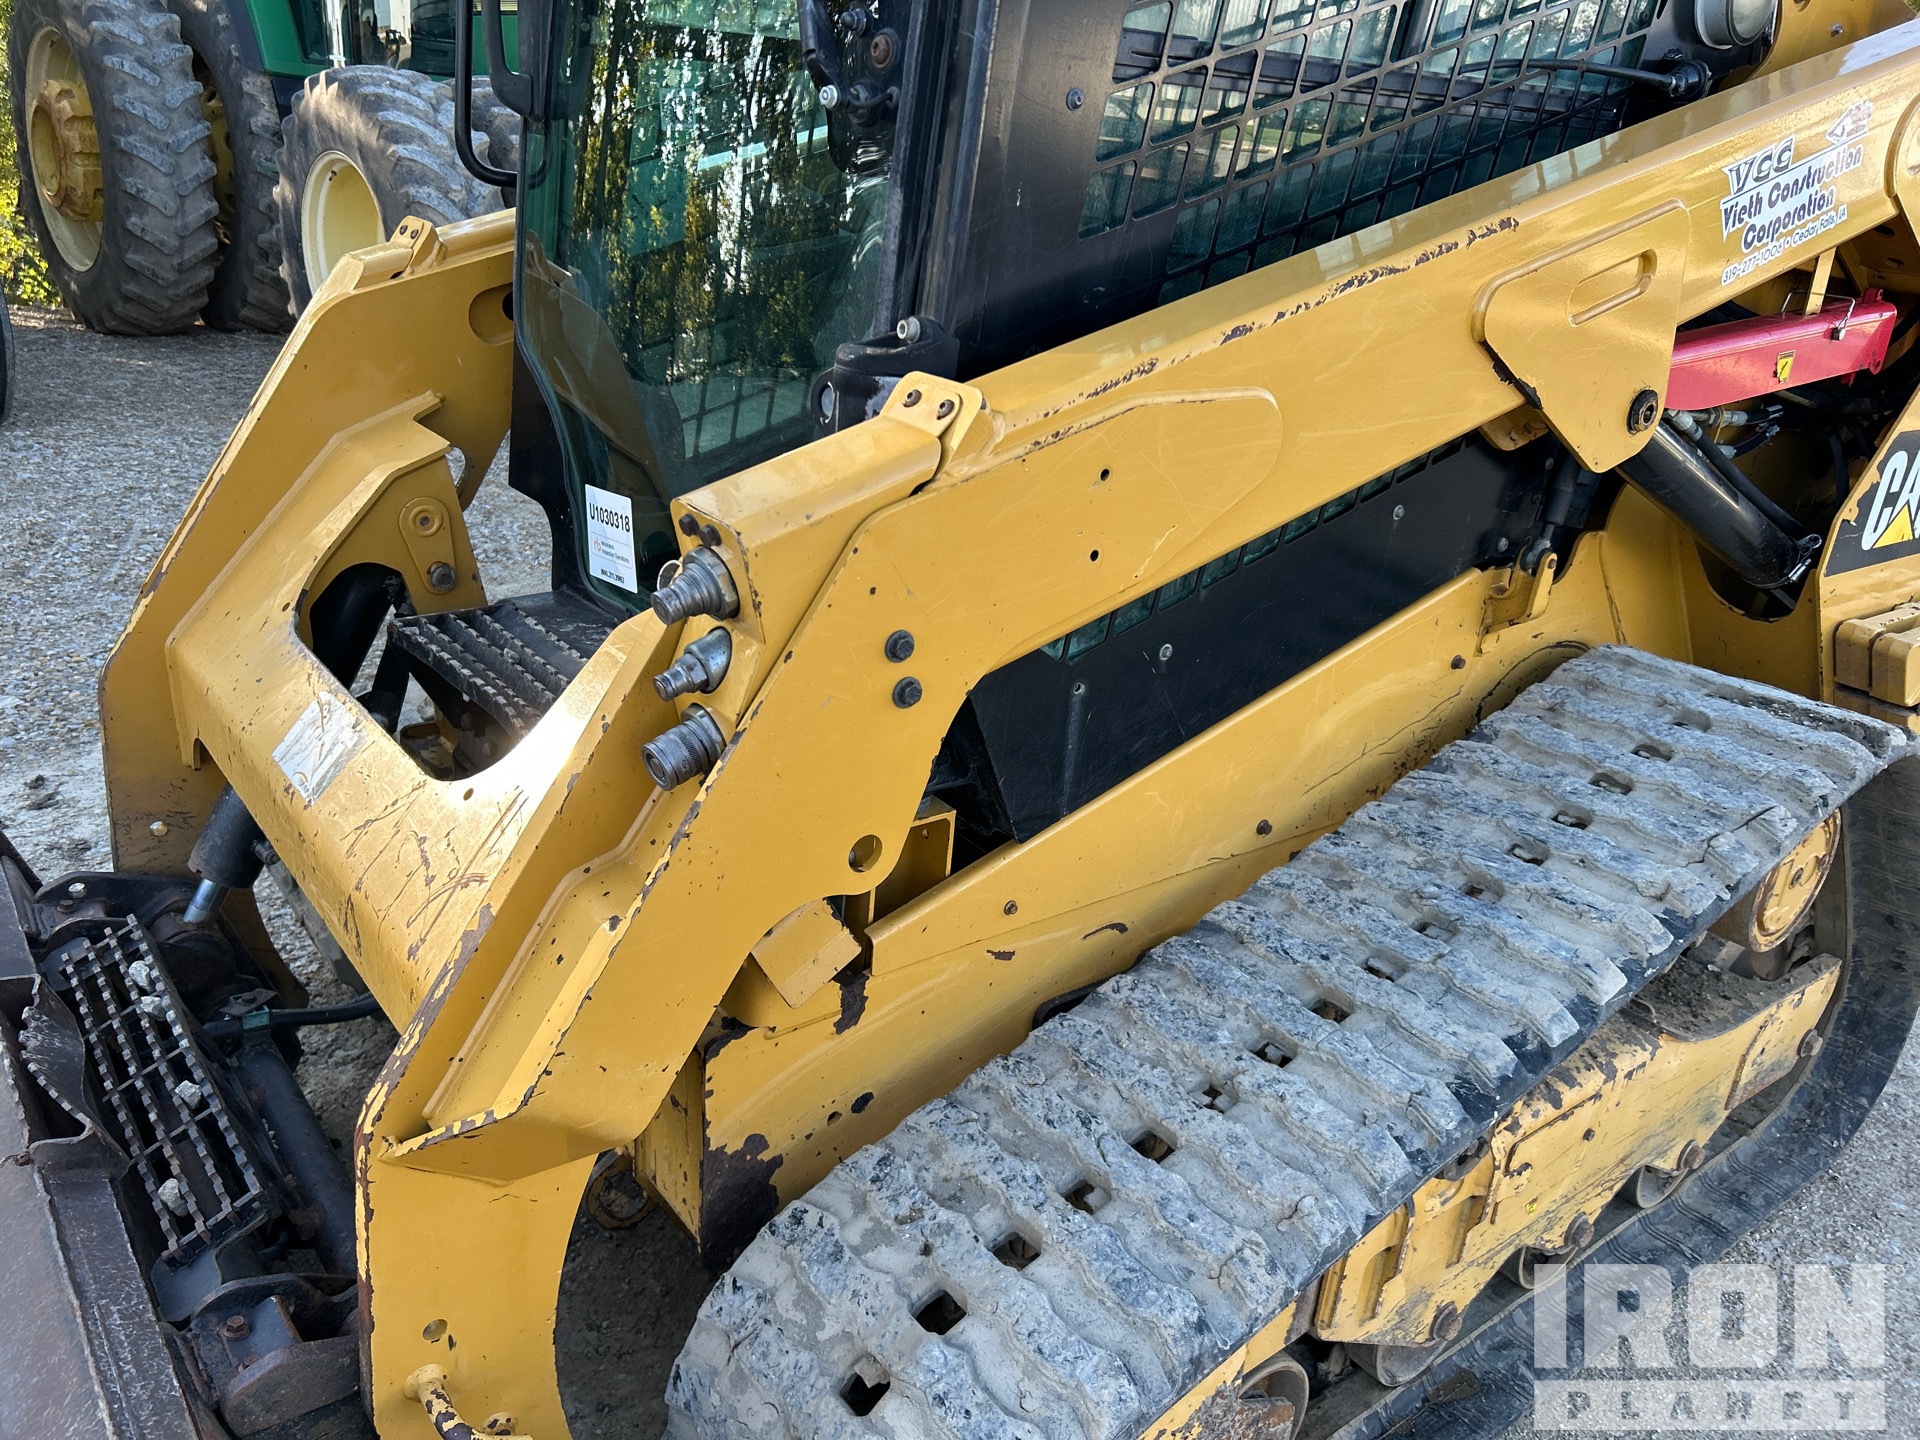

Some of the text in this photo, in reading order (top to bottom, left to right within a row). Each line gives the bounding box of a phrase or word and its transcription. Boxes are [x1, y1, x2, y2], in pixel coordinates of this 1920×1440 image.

[1724, 146, 1862, 231] Vieth Construction
[1728, 137, 1794, 195] VCC
[1743, 188, 1835, 250] Corporation
[1723, 244, 1783, 283] 319-277-1006
[589, 503, 630, 532] U1030318
[1861, 449, 1920, 551] CA
